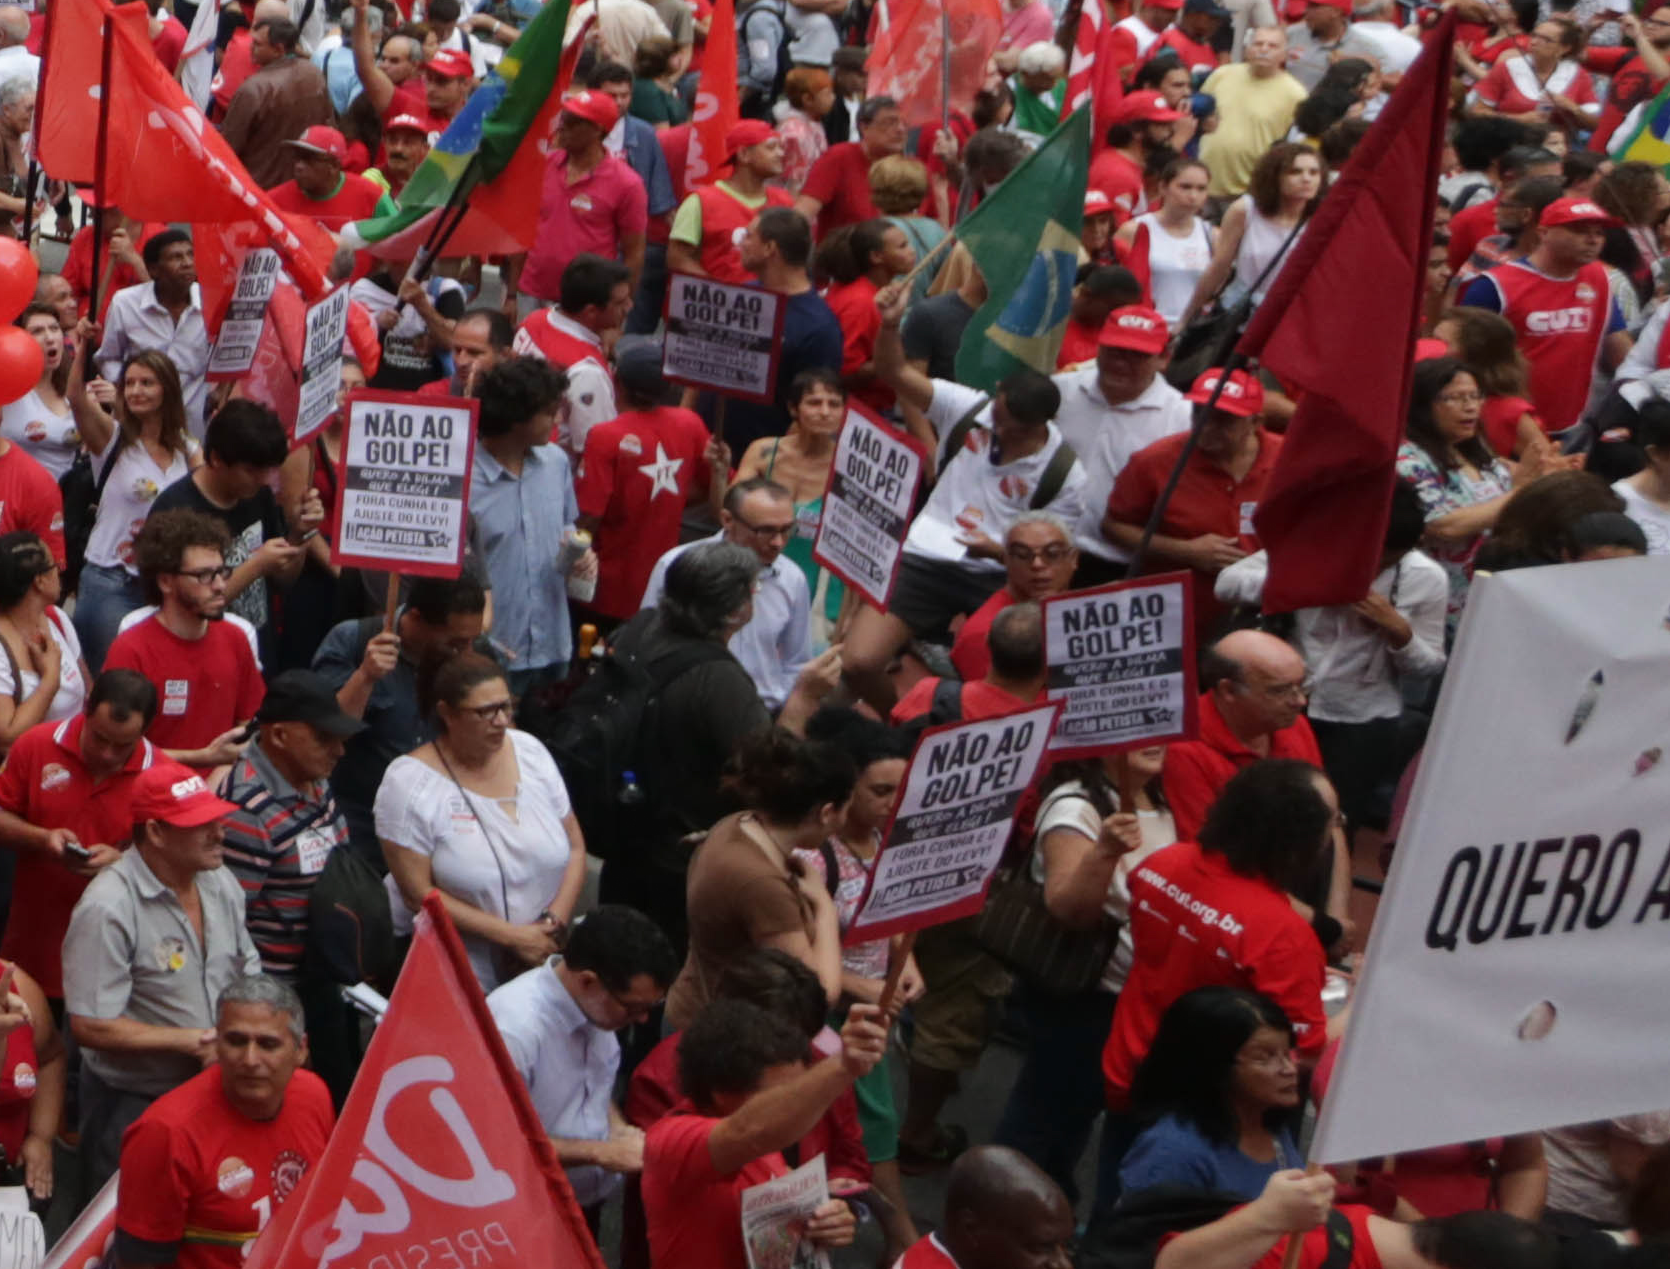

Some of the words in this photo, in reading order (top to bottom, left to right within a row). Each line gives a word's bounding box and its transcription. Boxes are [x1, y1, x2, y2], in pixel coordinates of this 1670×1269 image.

[682, 282, 727, 307] NÃO
[732, 293, 762, 316] AO
[683, 298, 761, 331] GOLPE!
[1118, 313, 1155, 331] CUT
[1525, 307, 1592, 333] CUT
[1203, 377, 1243, 399] CUT
[363, 409, 413, 438] NÃO
[420, 415, 453, 440] AO
[365, 440, 450, 467] GOLPE!
[848, 425, 881, 464] NÃO
[884, 445, 910, 481] AO
[846, 453, 902, 506] GOLPE!
[1061, 601, 1119, 634] NÃO
[1128, 592, 1165, 622] AO
[1067, 619, 1163, 659] GOLPE!
[926, 731, 990, 778] NÃO
[992, 720, 1035, 760] AO
[170, 774, 206, 800] CUT
[920, 756, 1023, 810] GOLPE!
[1422, 827, 1643, 952] QUERO
